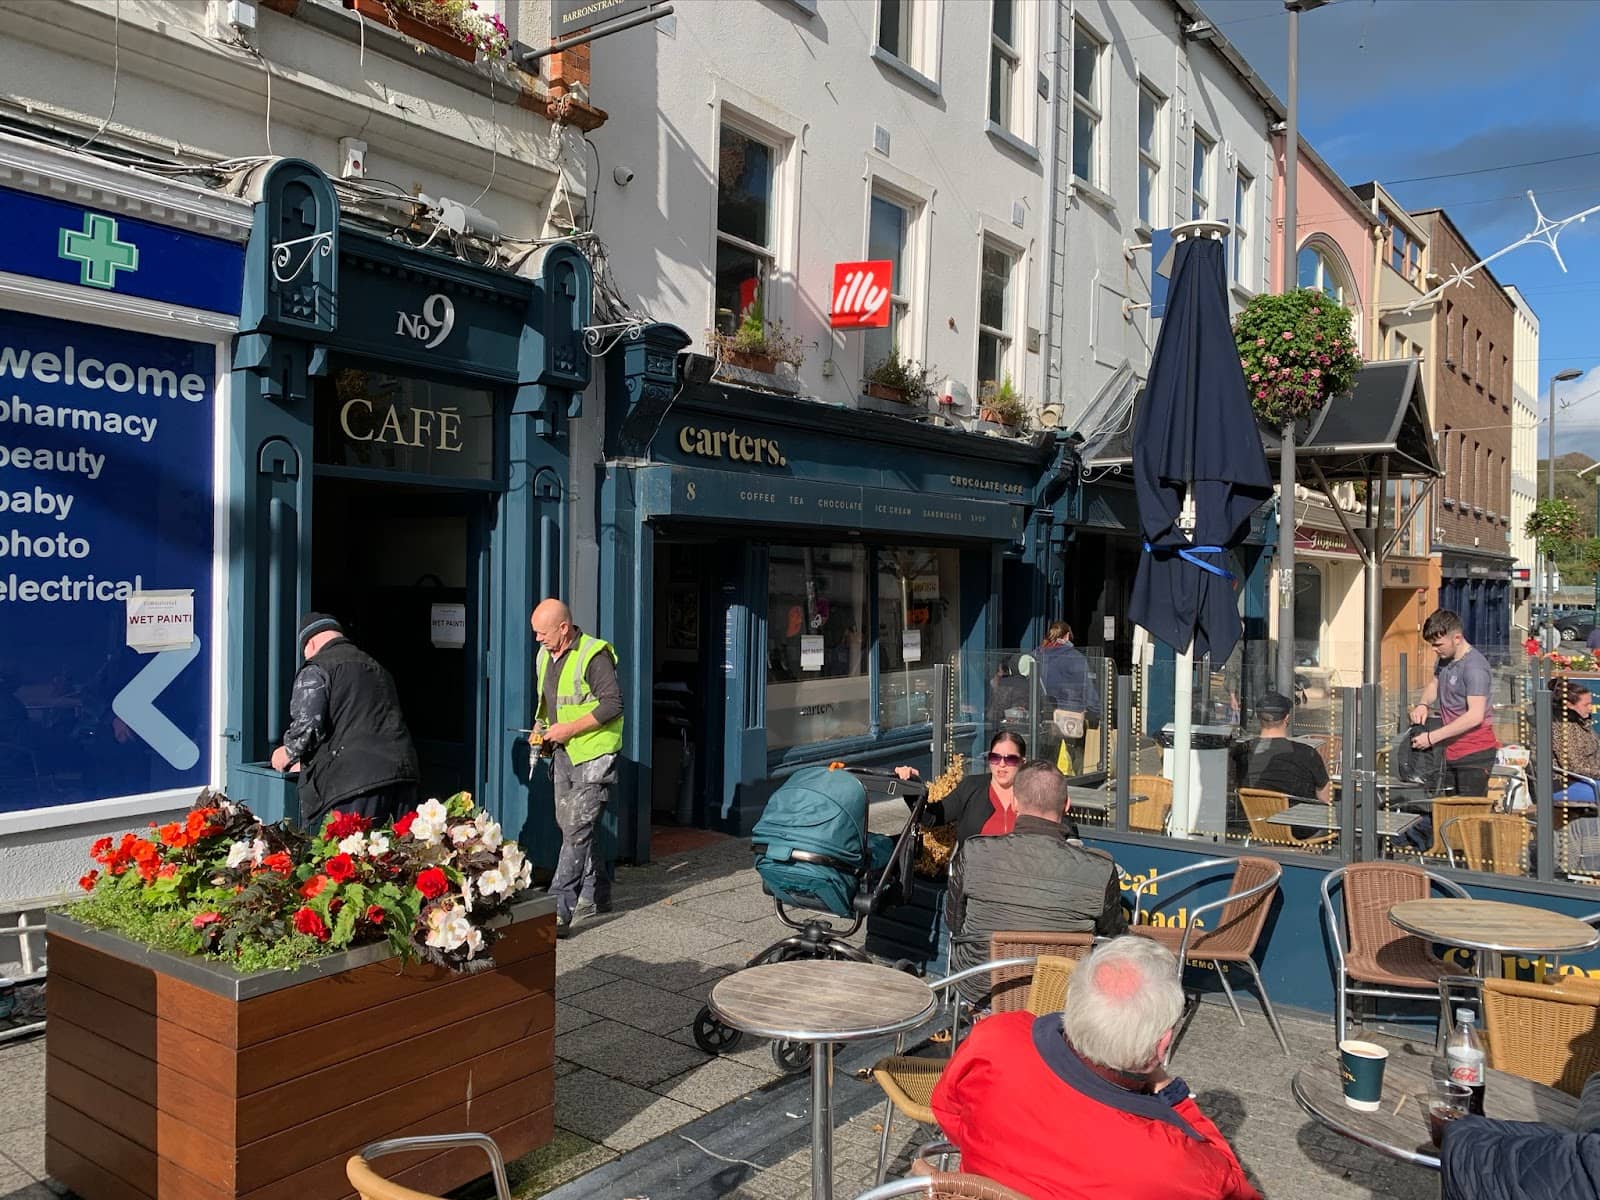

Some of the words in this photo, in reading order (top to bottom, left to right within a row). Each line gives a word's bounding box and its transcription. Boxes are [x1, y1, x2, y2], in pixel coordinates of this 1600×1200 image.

[834, 270, 888, 322] illy
[0, 346, 206, 402] welcome
[679, 425, 787, 467] carters.
[686, 481, 697, 501] 8
[950, 475, 1000, 491] CHOCOLATE
[740, 491, 775, 503] COFFEE
[789, 496, 805, 505] TEA
[818, 498, 863, 510] CHOCOLATE
[129, 615, 154, 625] WET
